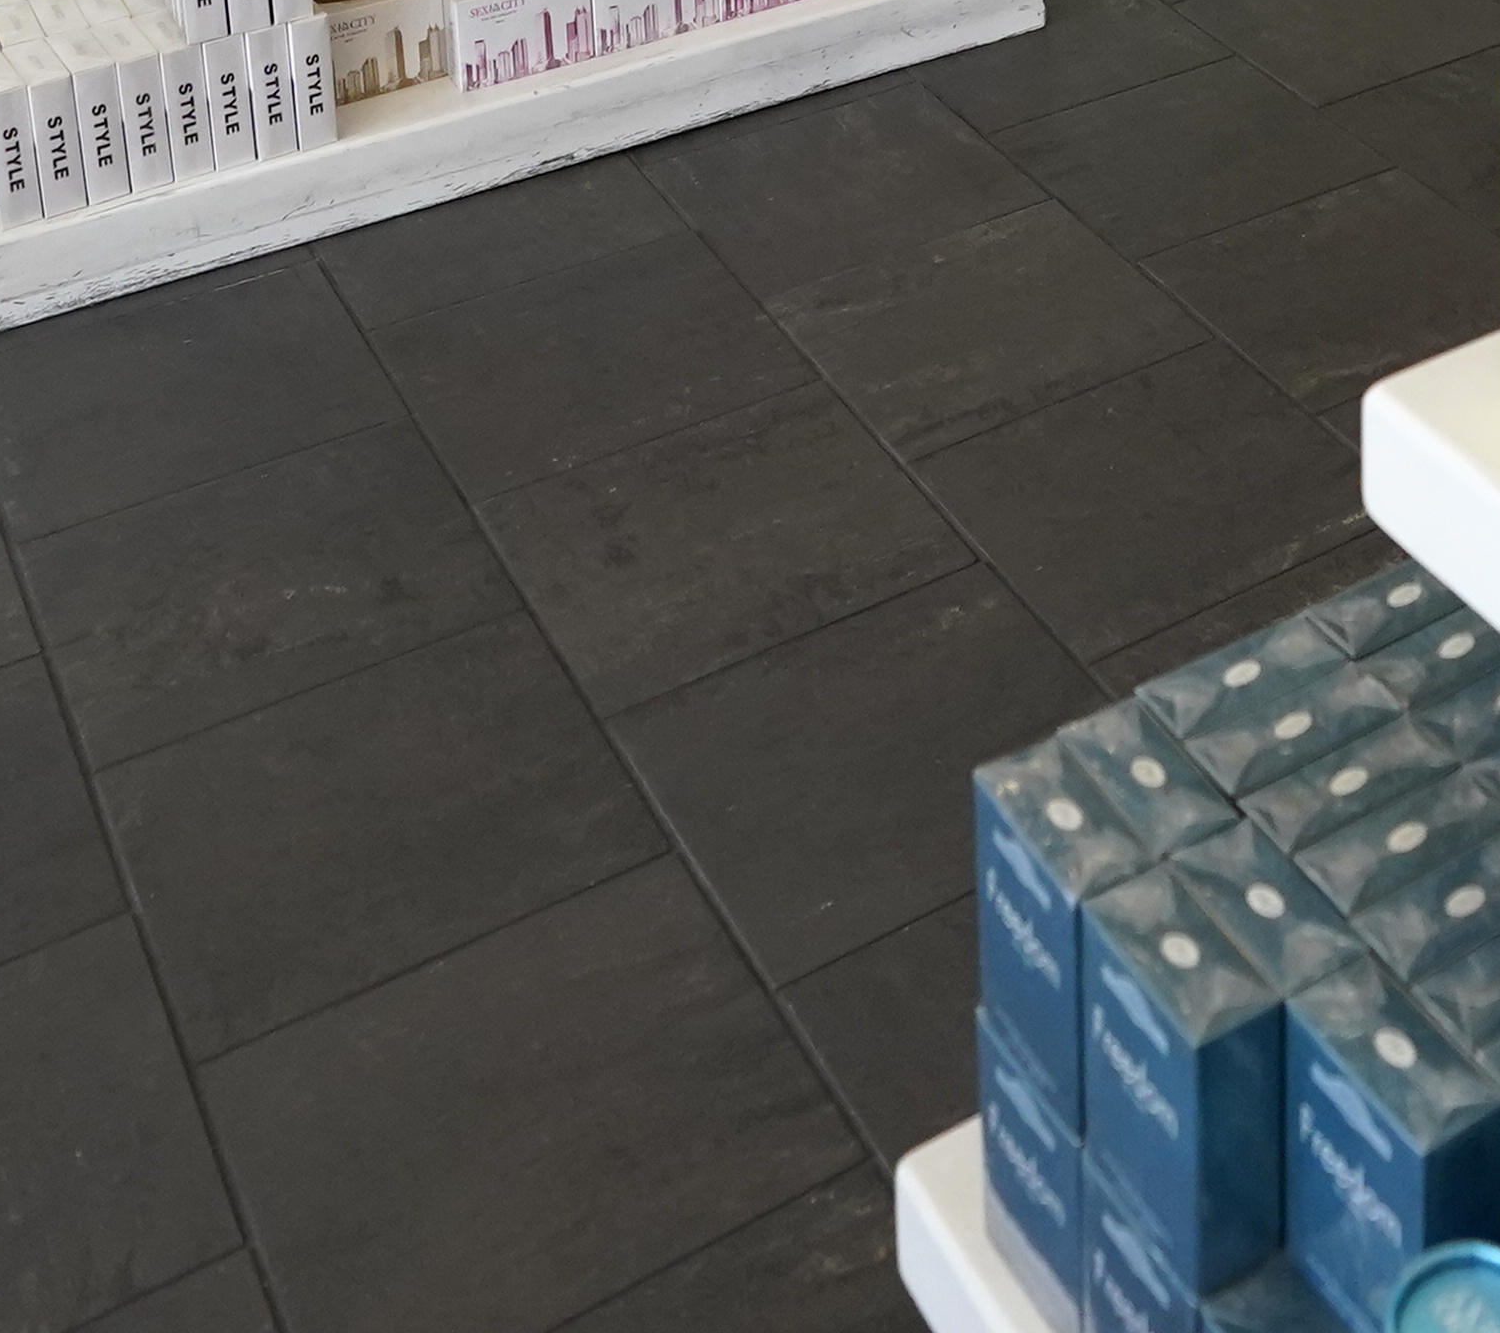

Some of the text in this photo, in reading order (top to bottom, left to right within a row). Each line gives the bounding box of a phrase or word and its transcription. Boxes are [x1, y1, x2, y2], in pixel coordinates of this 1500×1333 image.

[178, 82, 199, 146] STYLE
[305, 53, 324, 116] STYLE
[3, 127, 25, 193] STYLE
[92, 103, 113, 168] STYLE
